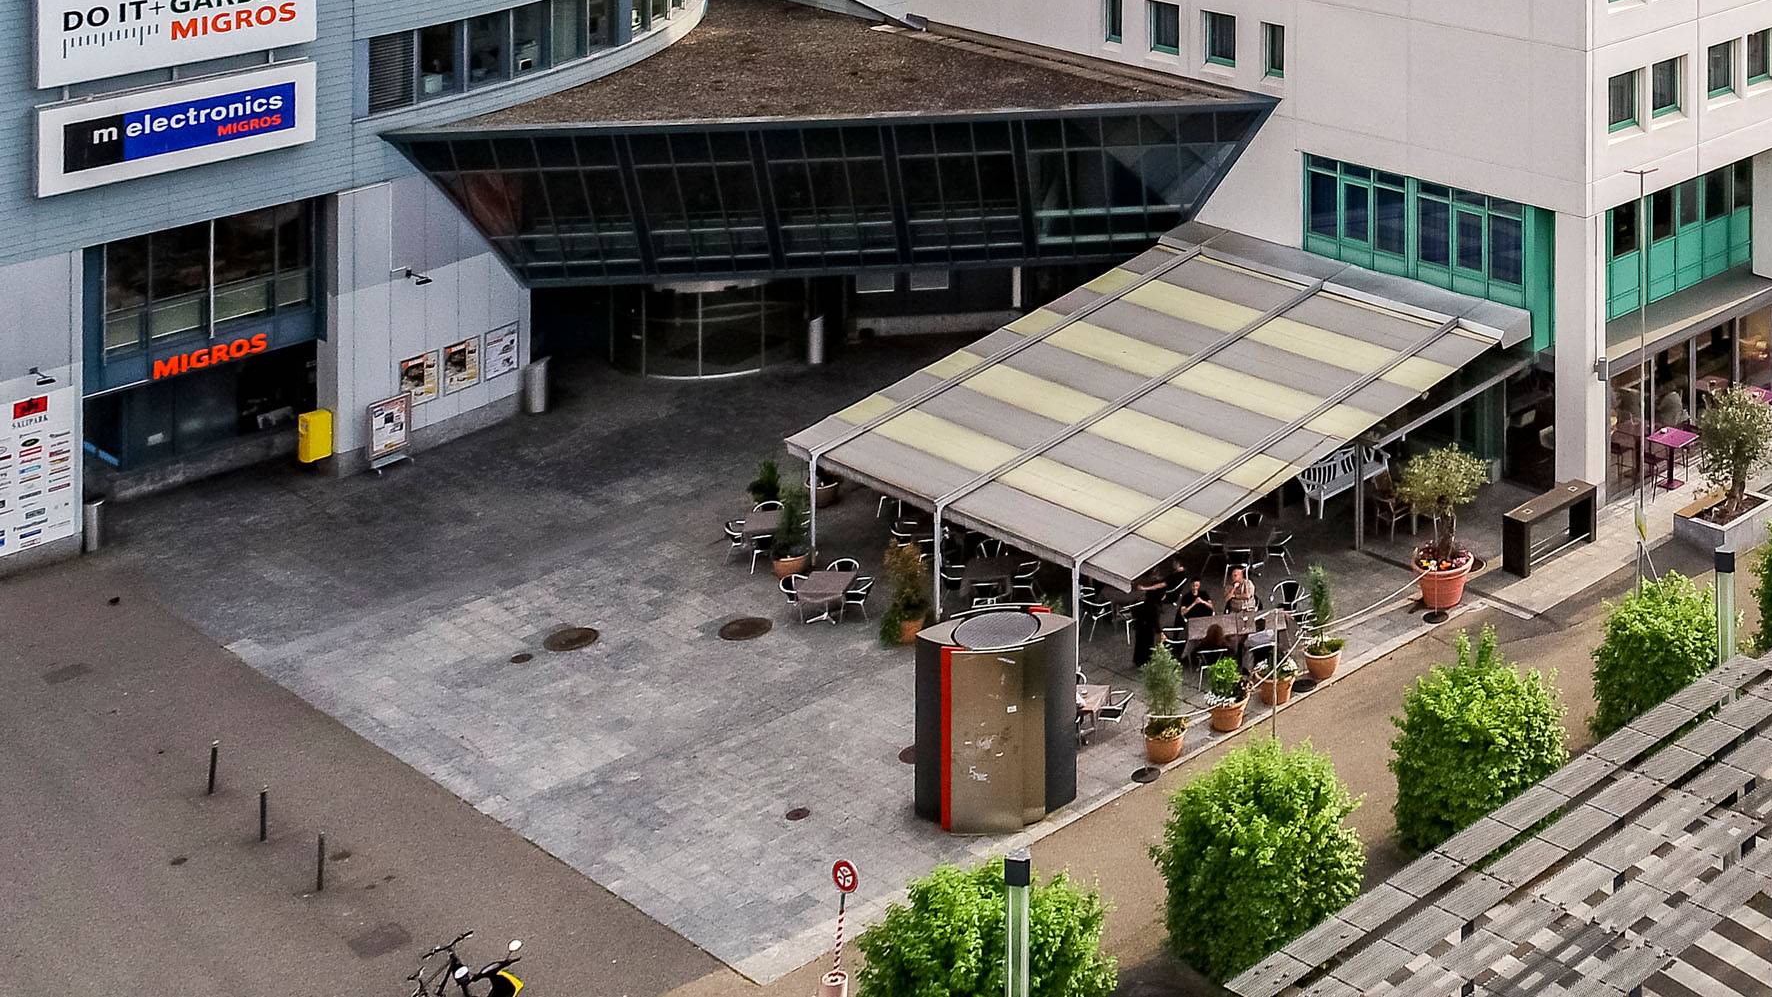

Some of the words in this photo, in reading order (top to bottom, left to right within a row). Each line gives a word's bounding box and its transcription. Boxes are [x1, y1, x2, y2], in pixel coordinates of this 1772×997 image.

[63, 5, 110, 33] DO
[170, 1, 297, 41] MIGROS
[92, 124, 118, 145] m
[125, 93, 284, 138] electronics
[216, 113, 283, 137] MIGROS
[152, 332, 269, 381] MIGROS
